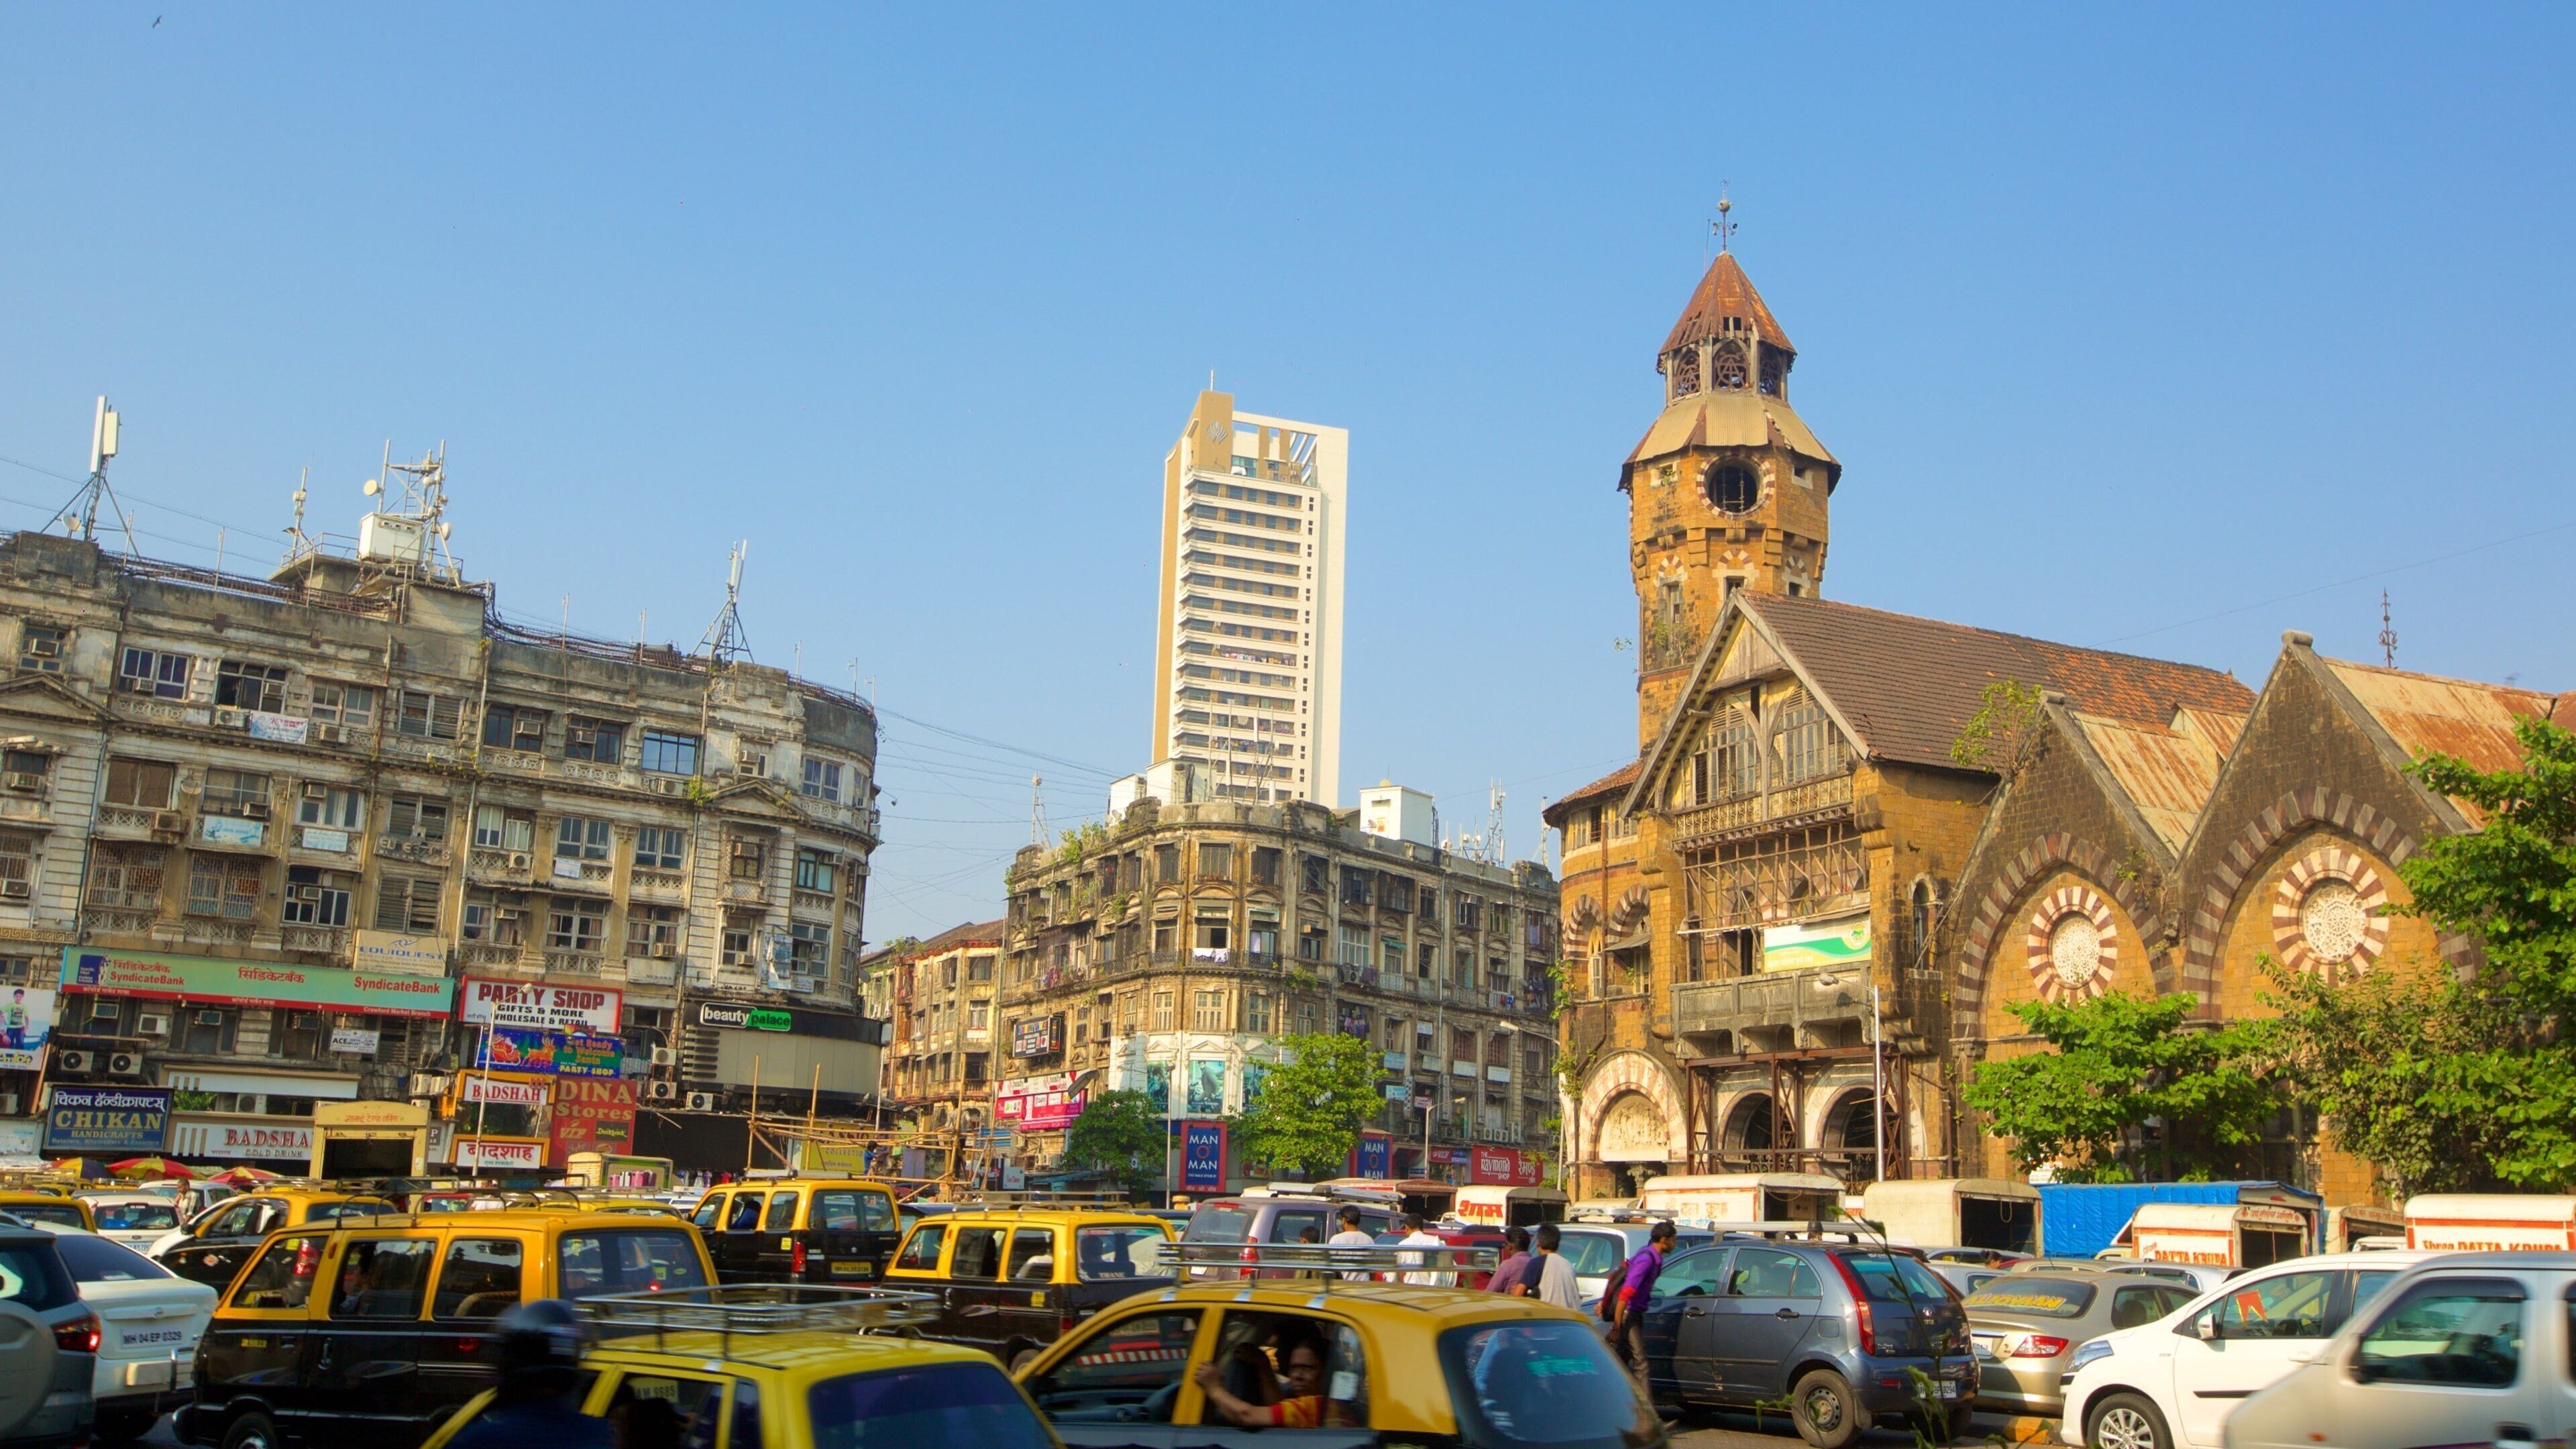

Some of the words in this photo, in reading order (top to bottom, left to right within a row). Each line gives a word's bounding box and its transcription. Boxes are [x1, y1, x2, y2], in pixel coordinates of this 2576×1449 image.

[110, 971, 184, 985] SyndicateBank
[354, 976, 440, 994] SyndicateBank
[478, 983, 545, 1006] PARTY
[553, 990, 604, 1010] SHOP
[364, 1006, 390, 1014] Crawford
[498, 1005, 532, 1014] GIFTS
[550, 1010, 584, 1018] MORE
[491, 1014, 545, 1024] WHOLESALE
[704, 1007, 749, 1025] beauty
[751, 1014, 790, 1026] palace
[586, 1039, 612, 1050] Ready
[576, 1048, 614, 1057] Welcome
[559, 1065, 589, 1073] PARTY
[592, 1067, 614, 1076] SHOP
[472, 1084, 541, 1101] BADSHAH
[558, 1080, 633, 1104] DINA
[54, 1091, 93, 1106] चिकन
[555, 1102, 633, 1120] Stores
[55, 1110, 163, 1129] CHIKAN
[71, 1130, 144, 1139] HANDICRAFTS
[225, 1128, 313, 1148] BADSHA
[1189, 1135, 1218, 1144] MAN
[466, 1144, 535, 1161] बादशाह
[826, 1148, 863, 1157] COLLECTIO
[1365, 1142, 1384, 1153] MAN
[274, 1150, 303, 1158] DRINK
[1188, 1160, 1217, 1170] MAN
[1364, 1169, 1383, 1179] MAN
[1458, 1200, 1503, 1218] शाम
[2458, 1242, 2502, 1250] DATTA
[2155, 1251, 2189, 1263] DATTA
[2193, 1252, 2226, 1265] KRUPA
[123, 1334, 137, 1344] MH
[139, 1334, 149, 1343] 04
[150, 1332, 160, 1342] EP
